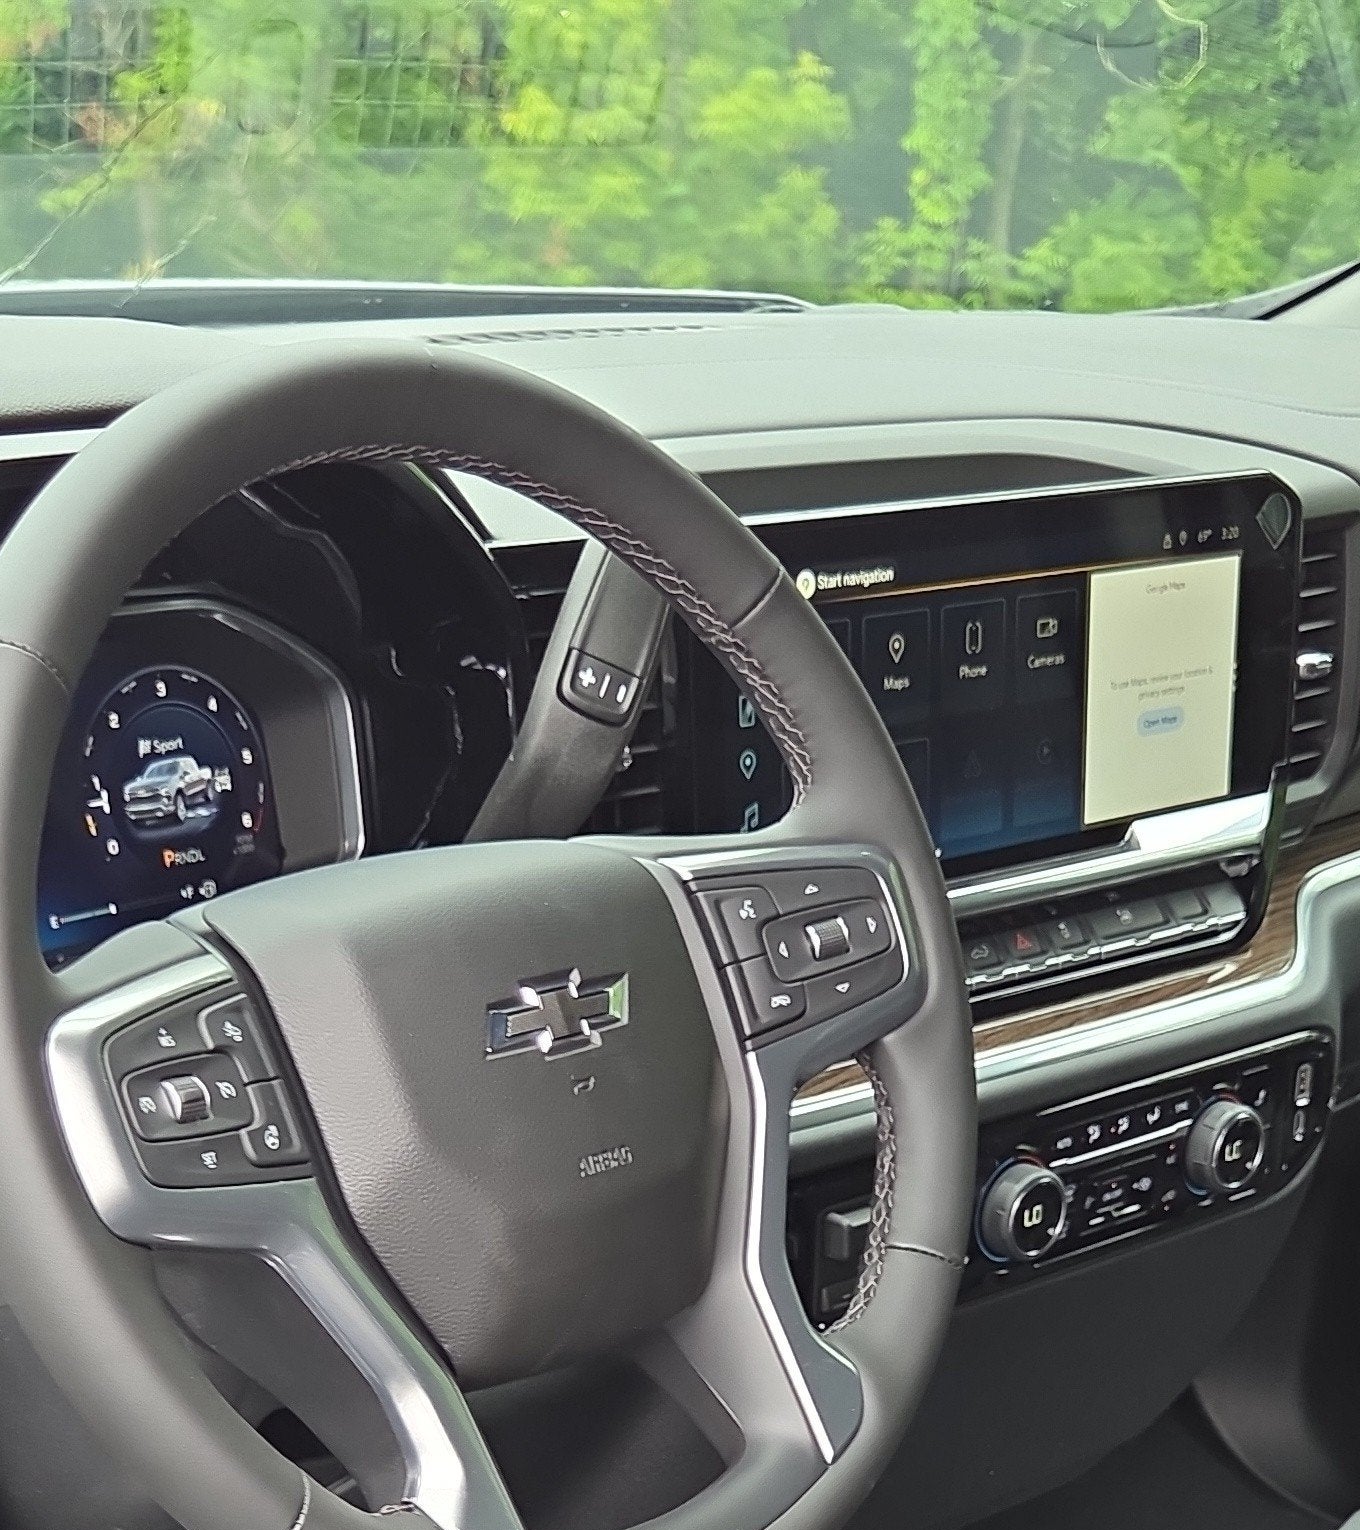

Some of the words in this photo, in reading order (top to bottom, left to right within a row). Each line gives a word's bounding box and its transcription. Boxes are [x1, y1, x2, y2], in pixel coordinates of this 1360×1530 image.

[817, 571, 842, 590] Start
[843, 566, 895, 588] navigation
[1027, 653, 1065, 669] Cameras
[959, 665, 987, 680] Phone
[883, 676, 911, 691] Maps
[152, 738, 184, 755] Sport
